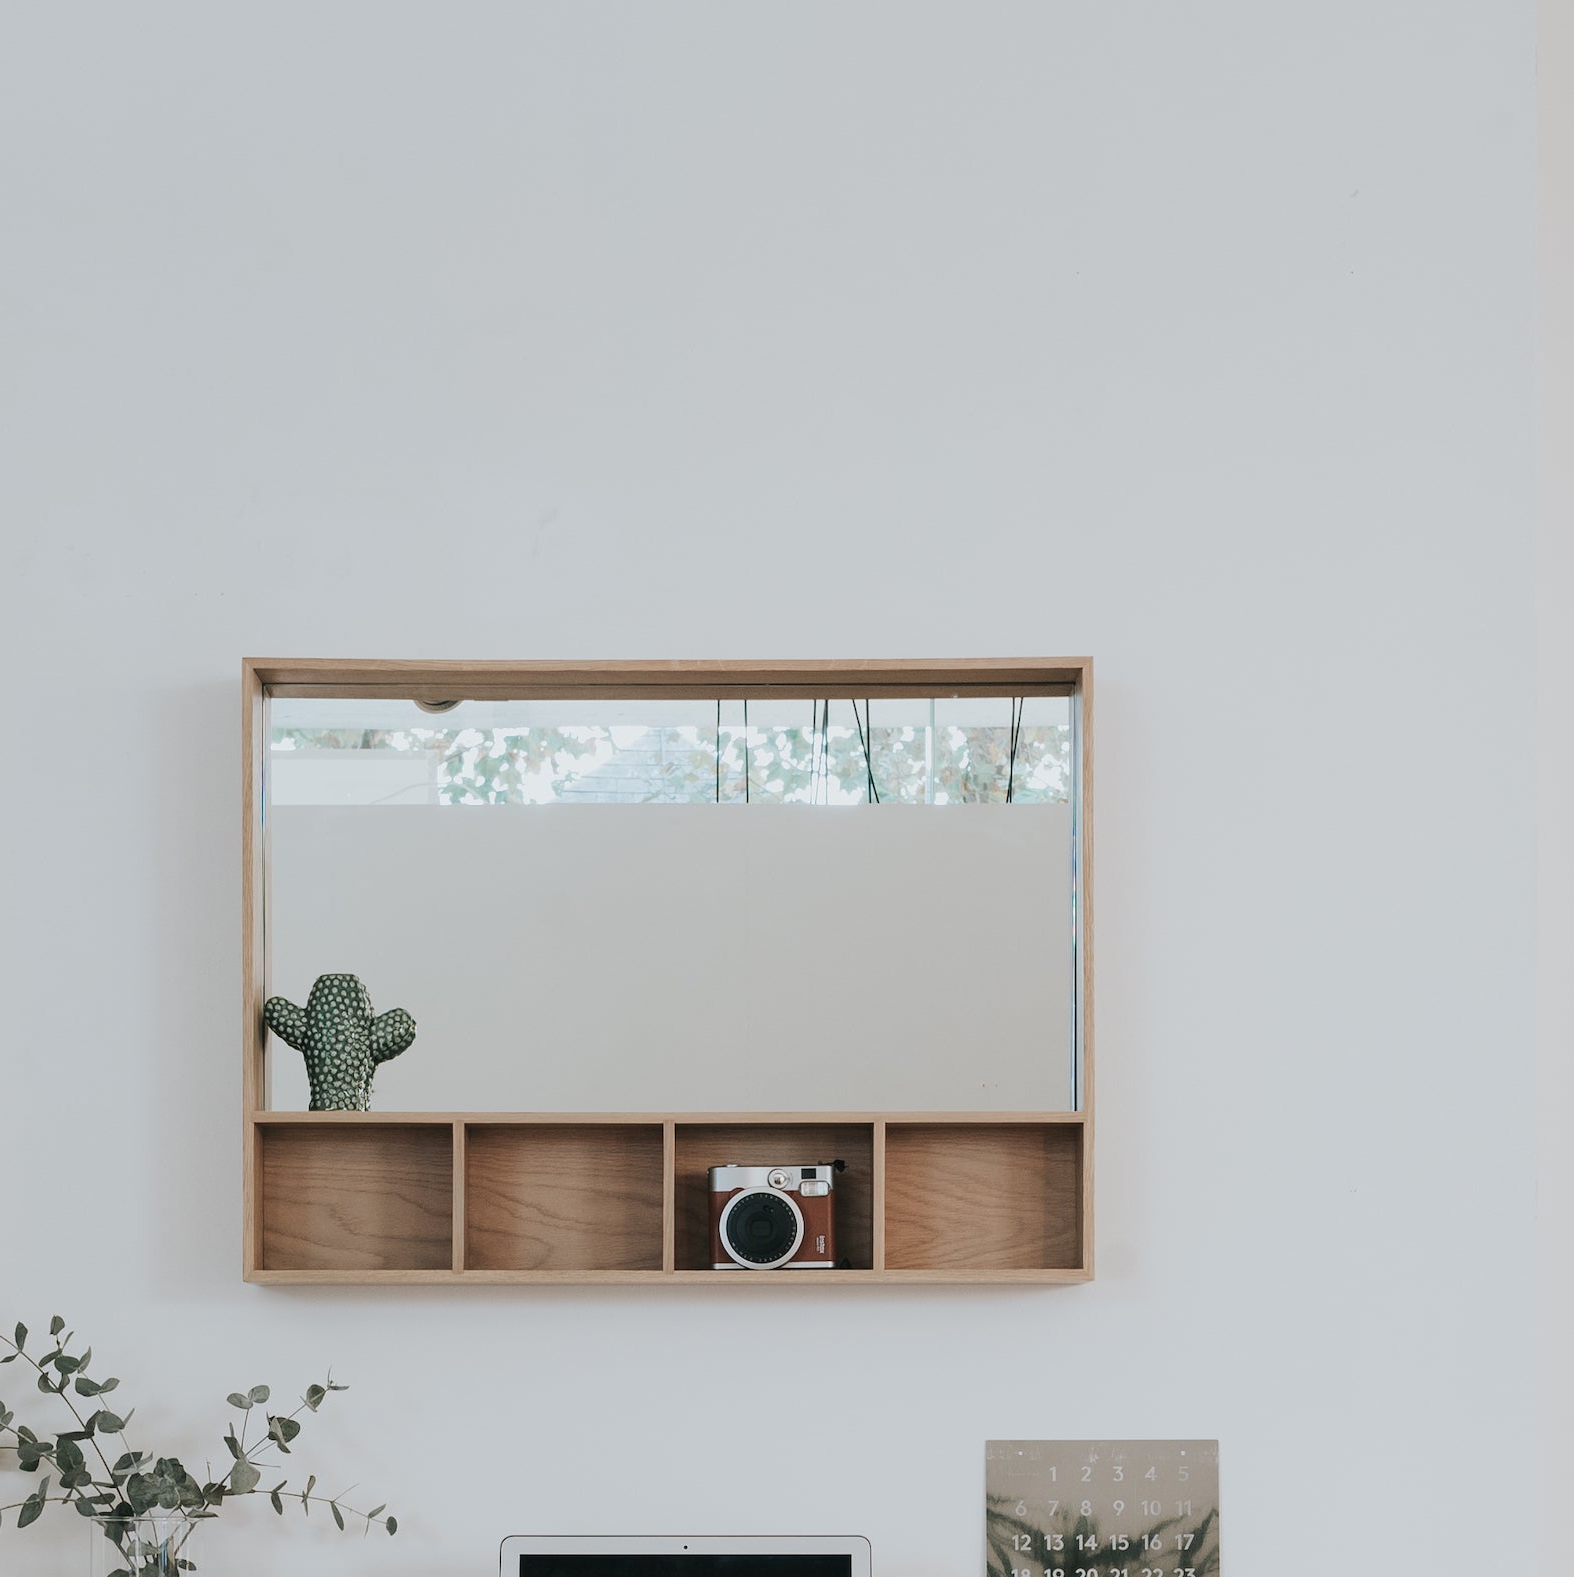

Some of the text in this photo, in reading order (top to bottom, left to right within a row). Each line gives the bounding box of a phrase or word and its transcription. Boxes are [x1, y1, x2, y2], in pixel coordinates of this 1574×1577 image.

[1048, 1466, 1190, 1483] 1 2 3 4 5
[1014, 1500, 1192, 1517] 6 7 8 9 10 11
[1011, 1534, 1195, 1552] 12 13 14 15 16 17
